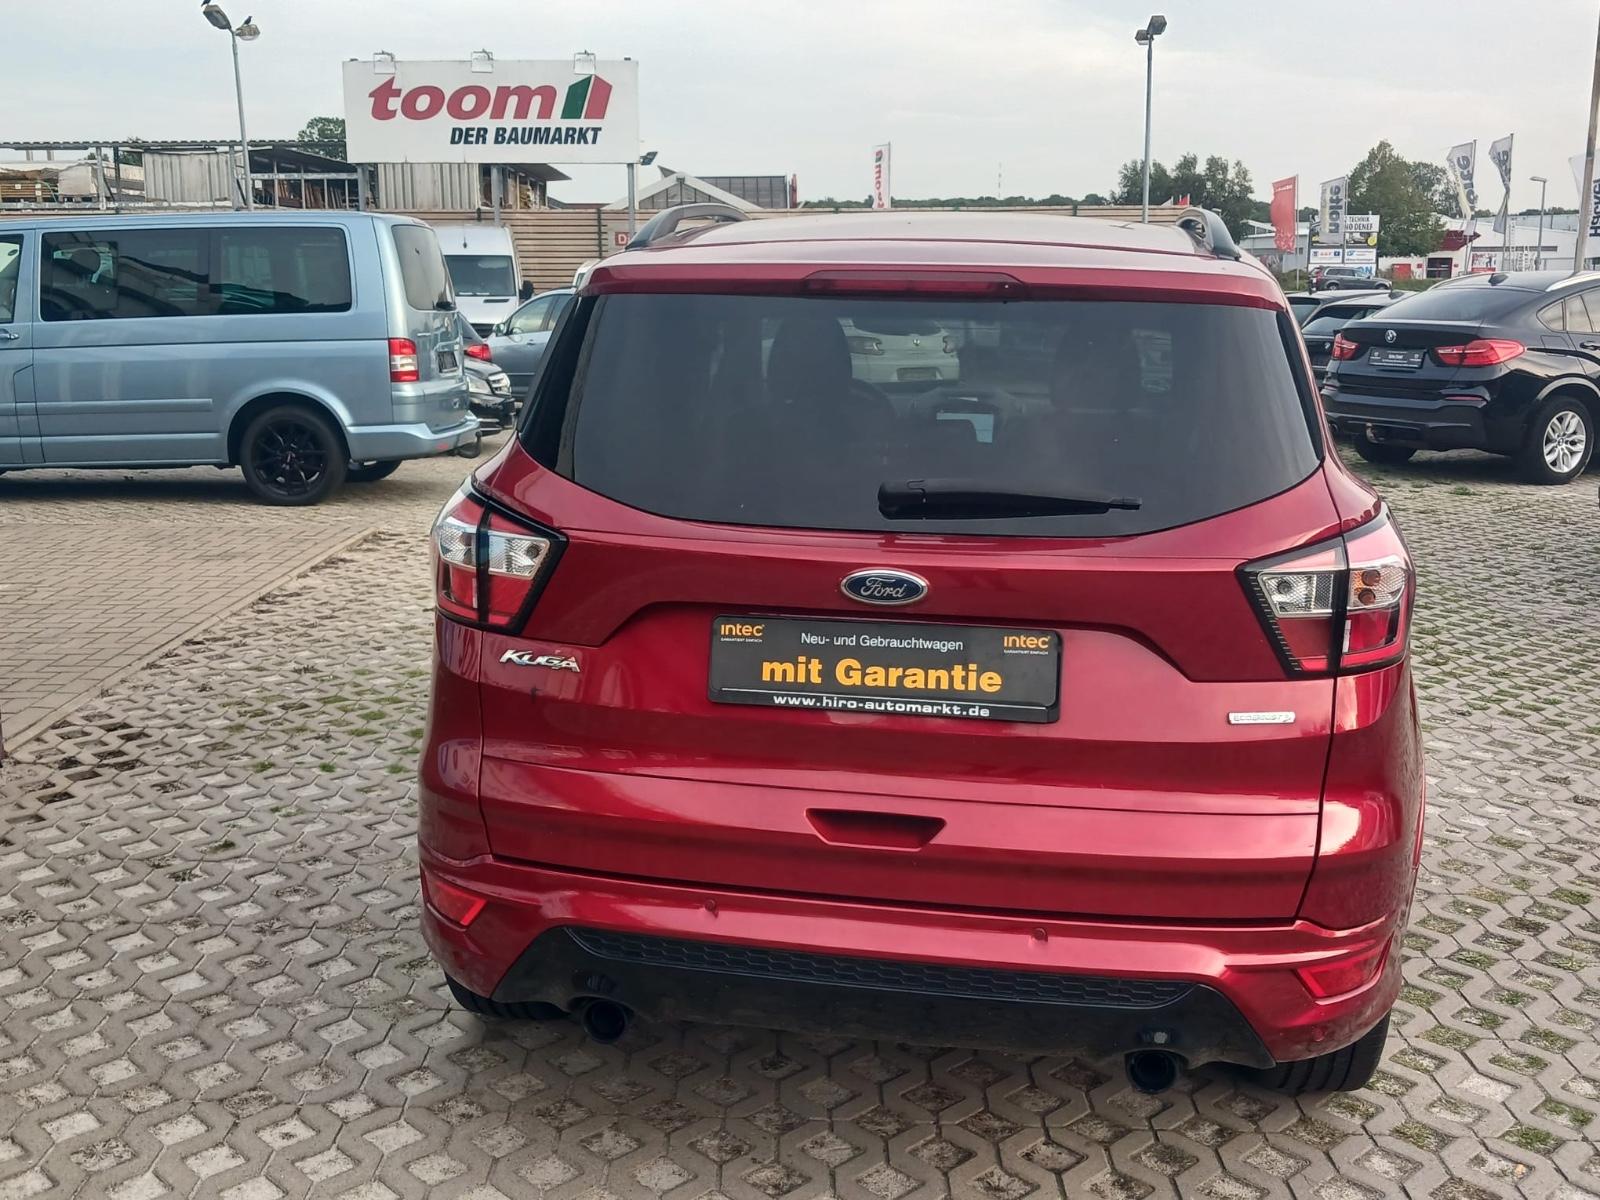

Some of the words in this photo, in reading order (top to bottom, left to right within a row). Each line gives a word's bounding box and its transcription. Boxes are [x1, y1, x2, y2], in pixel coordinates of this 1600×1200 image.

[368, 76, 557, 120] toom
[450, 127, 488, 145] DER
[494, 127, 602, 145] BAUMARKT
[860, 577, 908, 597] Ford
[721, 623, 764, 637] intec
[801, 632, 830, 645] Neu-
[833, 635, 856, 646] und
[859, 635, 963, 652] Gebrauchtwagen
[1004, 635, 1049, 649] intec
[499, 649, 580, 672] KUGA
[762, 656, 822, 684] mit
[835, 658, 1002, 693] Garantie
[773, 695, 990, 717] www.hiro-automarkt.de
